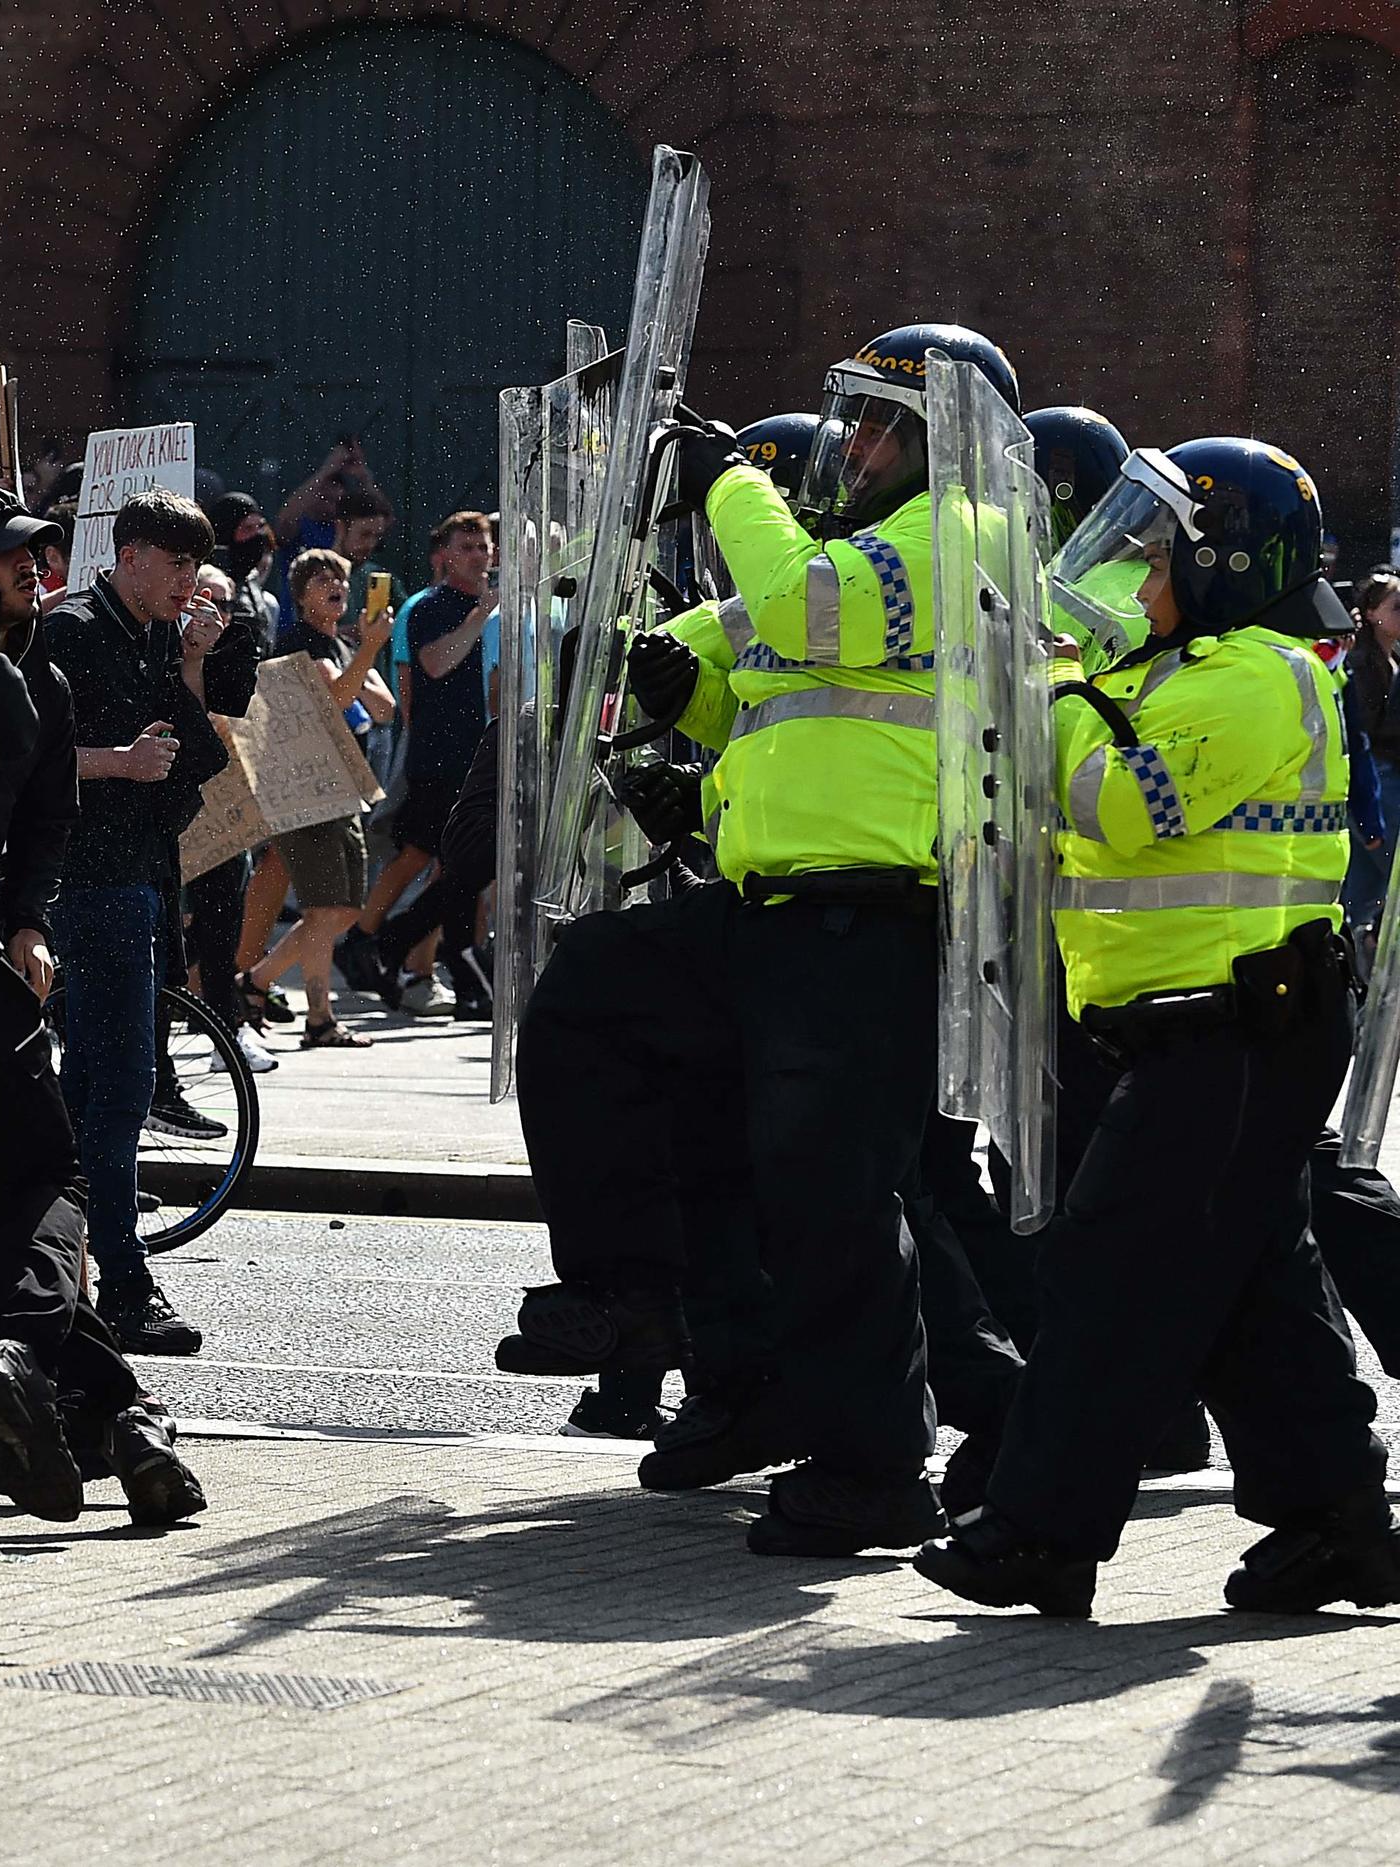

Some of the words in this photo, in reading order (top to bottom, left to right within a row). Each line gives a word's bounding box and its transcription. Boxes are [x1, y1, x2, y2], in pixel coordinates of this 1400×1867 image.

[92, 437, 115, 482] YOU
[146, 431, 157, 469] A
[158, 425, 190, 466] KNEE
[88, 479, 115, 515] FOR
[82, 513, 112, 563] YOU
